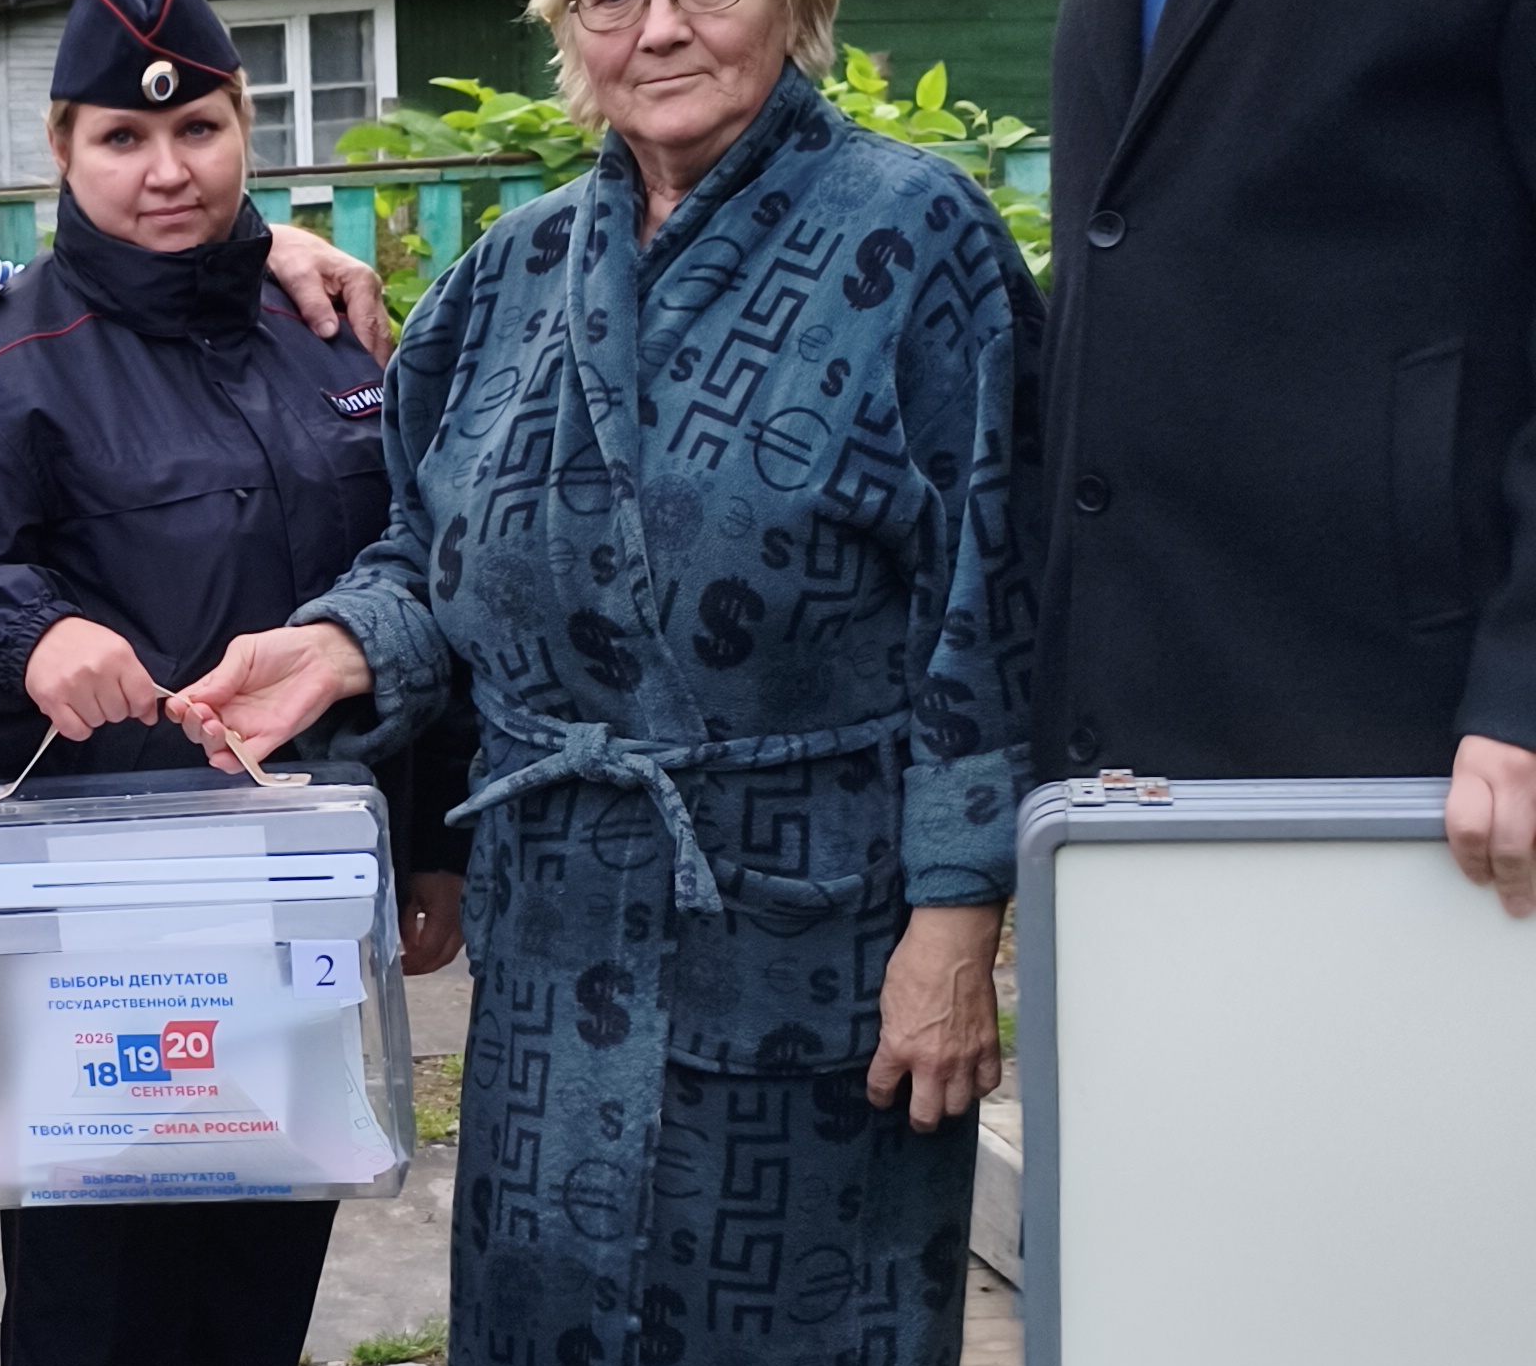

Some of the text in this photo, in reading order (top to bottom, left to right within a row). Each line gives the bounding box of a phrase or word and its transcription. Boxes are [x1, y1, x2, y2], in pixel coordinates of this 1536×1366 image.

[315, 954, 336, 986] 2
[49, 973, 228, 989] ВЫБОРЫ ДЕПУТАТОВ
[47, 995, 234, 1011] ГОСУДАРСТВЕННОЙ ДУМЫ
[74, 1032, 114, 1044] 2026
[82, 1031, 210, 1087] 18 19 20
[131, 1085, 219, 1098] СЕНТЯБРЯ
[29, 1122, 74, 1136] ТВОЙ
[78, 1124, 134, 1135] ГОЛОС
[153, 1122, 200, 1135] СИЛА
[204, 1121, 279, 1134] РОССИИ!
[82, 1172, 236, 1185] ВЫБОРЫ ДЕПУТАТОВ
[31, 1186, 149, 1200] НОВГОРОДСКОЙ
